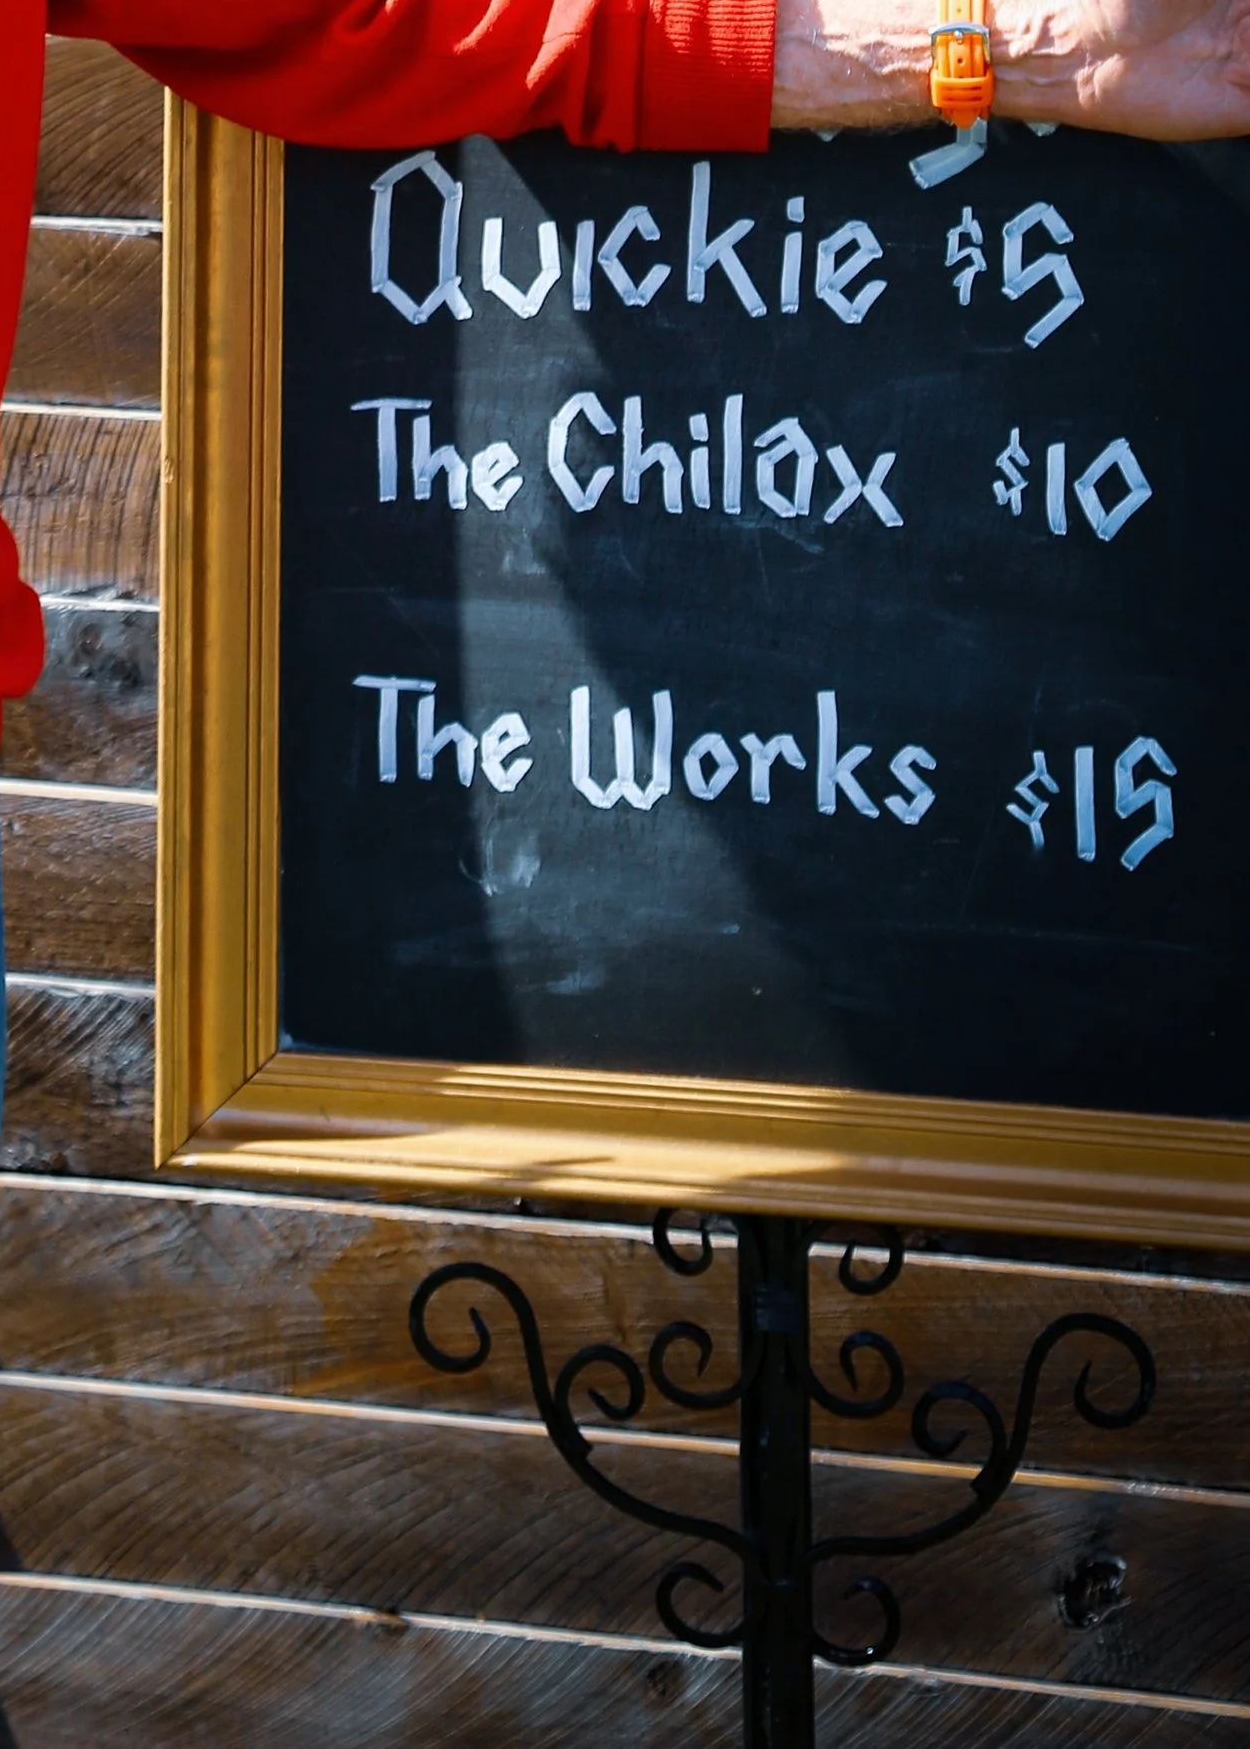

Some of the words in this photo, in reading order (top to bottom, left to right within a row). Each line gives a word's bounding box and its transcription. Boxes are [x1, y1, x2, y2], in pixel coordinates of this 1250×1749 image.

[370, 150, 887, 325] Quickie
[945, 201, 1085, 349] $5
[351, 397, 524, 512] The
[547, 391, 904, 529] Chilax
[993, 427, 1153, 543] $10
[353, 675, 533, 793] The
[570, 685, 938, 826] Works
[1007, 736, 1178, 872] $15
